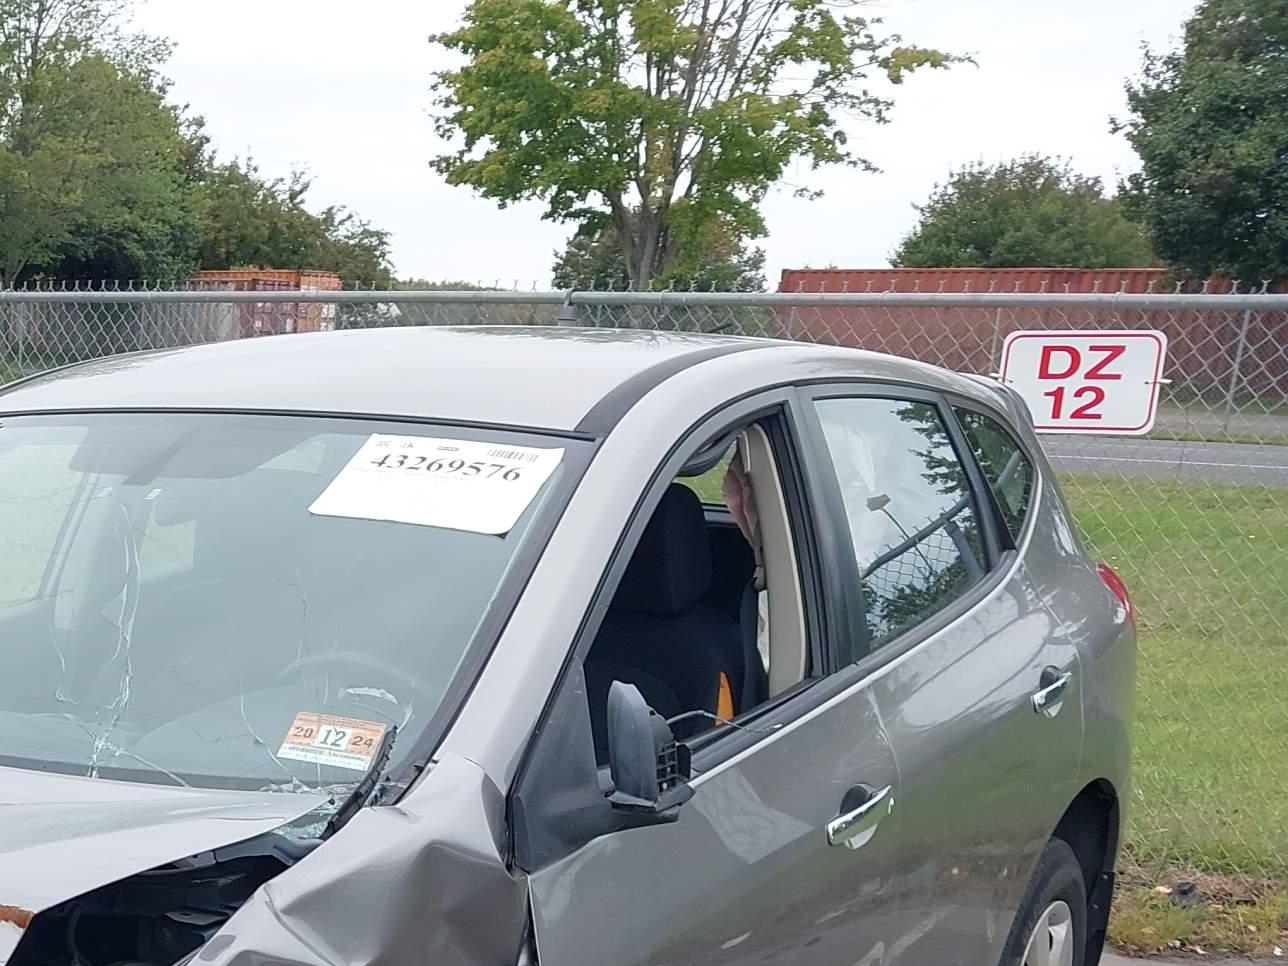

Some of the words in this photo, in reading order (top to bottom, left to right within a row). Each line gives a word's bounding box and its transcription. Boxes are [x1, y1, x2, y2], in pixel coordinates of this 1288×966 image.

[1037, 345, 1127, 380] DZ
[1043, 385, 1106, 419] 12
[370, 453, 521, 481] 43269576
[294, 726, 314, 739] 20
[319, 727, 347, 747] 12
[351, 735, 374, 748] 24
